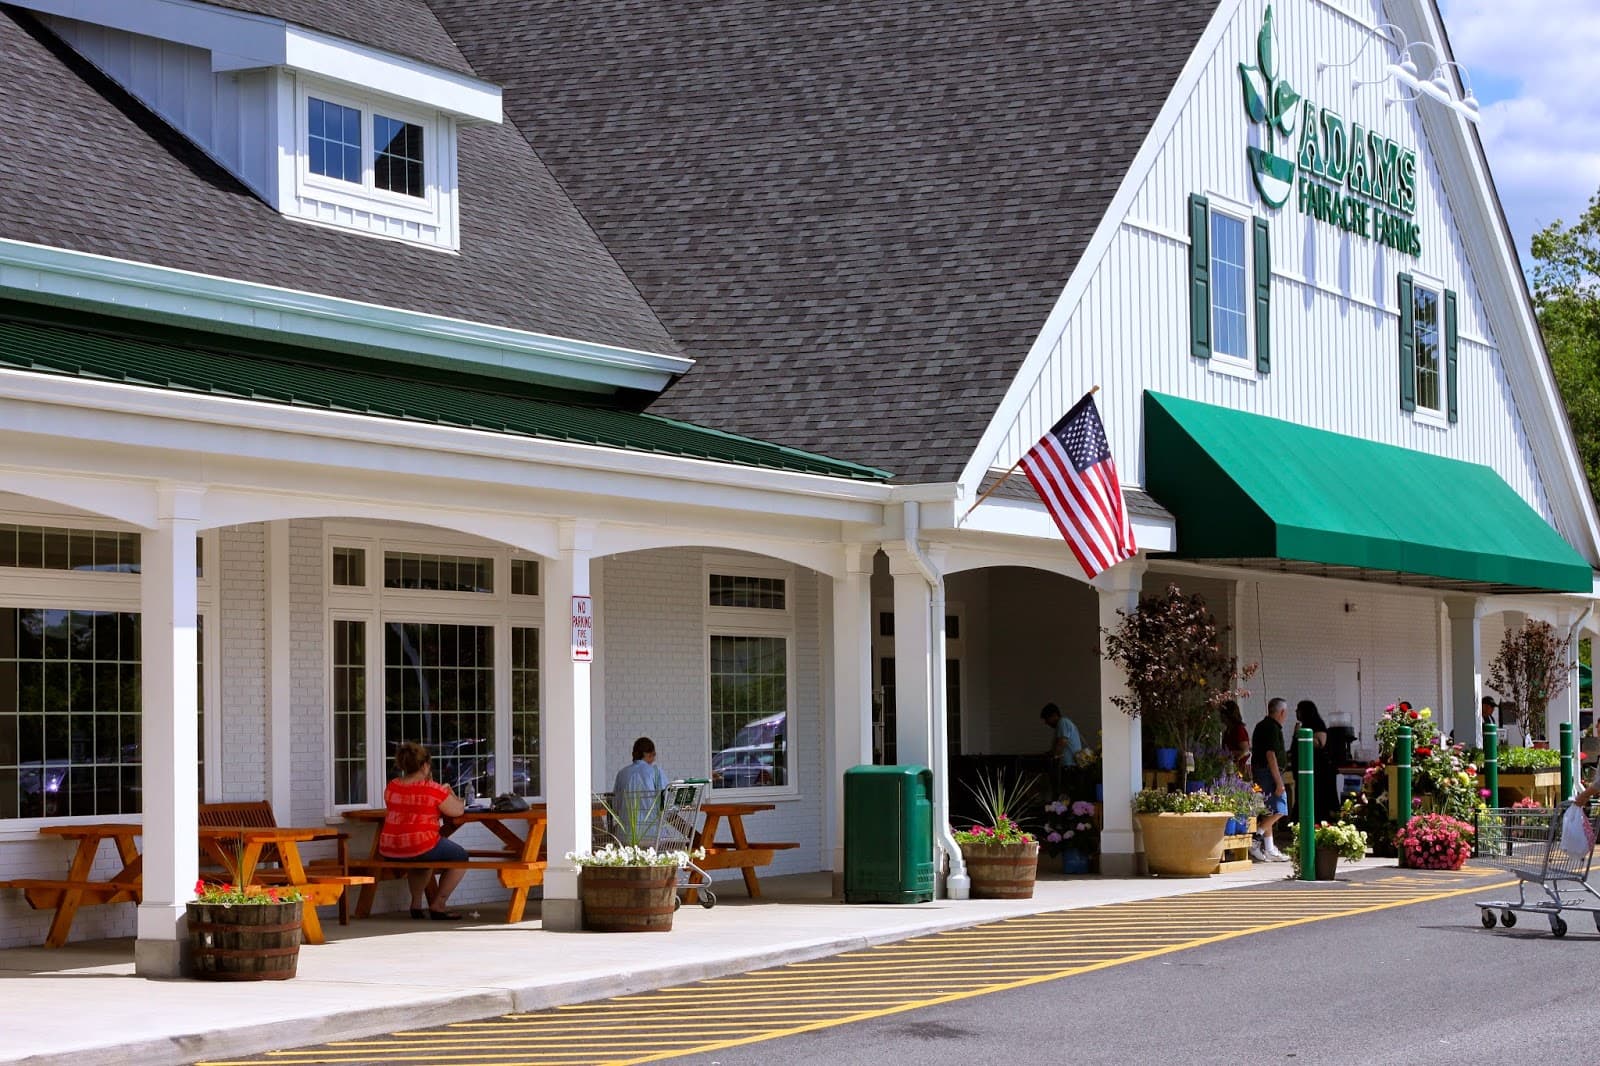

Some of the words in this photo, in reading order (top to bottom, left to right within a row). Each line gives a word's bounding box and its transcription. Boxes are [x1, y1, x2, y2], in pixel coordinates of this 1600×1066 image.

[1298, 99, 1416, 215] ADAMS
[1299, 176, 1371, 239] FAIRACRE
[1373, 207, 1422, 259] FARMS
[577, 601, 586, 614] NO
[573, 615, 592, 629] PARKING
[577, 629, 587, 639] FIRE
[576, 639, 588, 649] LANE
